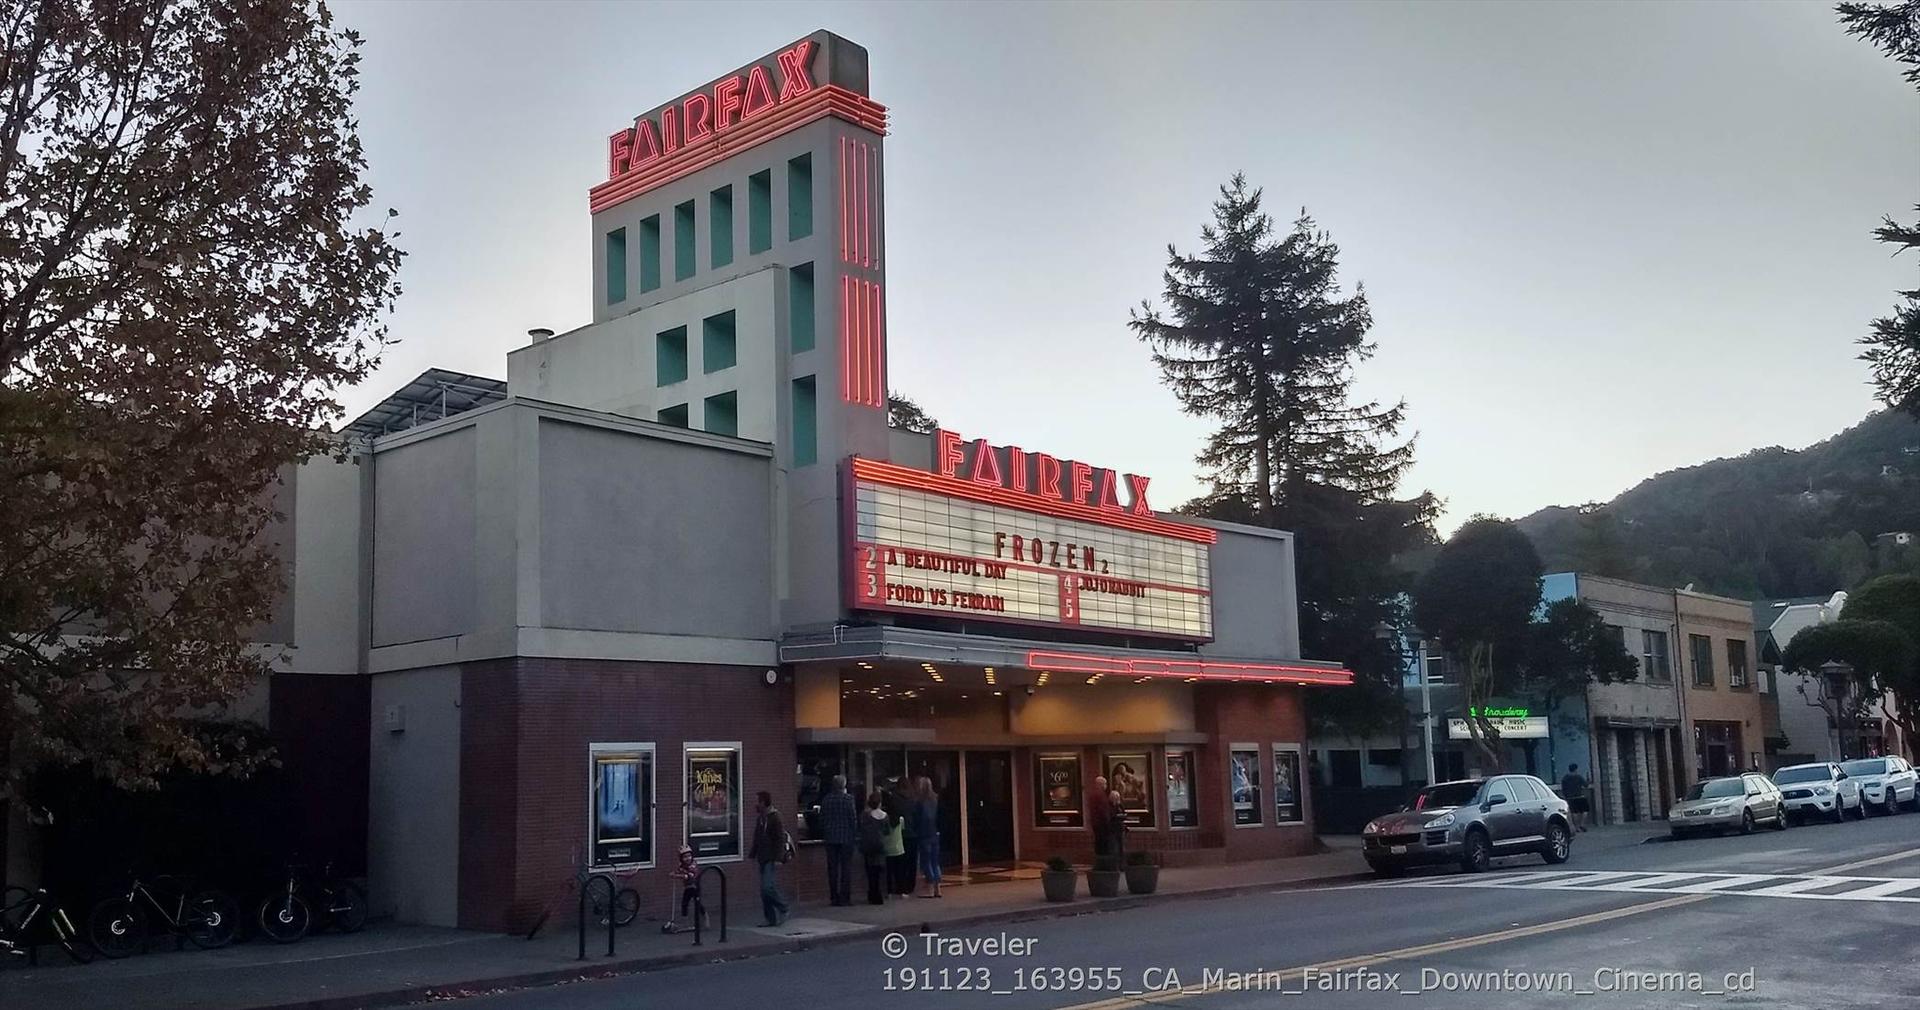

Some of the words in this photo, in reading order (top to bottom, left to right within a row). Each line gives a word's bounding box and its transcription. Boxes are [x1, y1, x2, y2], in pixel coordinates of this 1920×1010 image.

[608, 40, 813, 180] FAIRFAX
[935, 427, 1155, 518] FAIRFAX
[865, 546, 877, 569] 2
[886, 548, 898, 566] A
[903, 550, 981, 578] BEAUTIFUL
[984, 561, 1008, 580] DAY
[995, 531, 1095, 572] FROZEN
[1101, 558, 1109, 574] 2
[867, 574, 877, 597] 3
[886, 582, 925, 604] FORD
[929, 587, 947, 606] VS
[952, 590, 1005, 612] FERRARI
[1063, 574, 1073, 594] 4
[1065, 598, 1074, 618] 5
[696, 769, 722, 784] Knives
